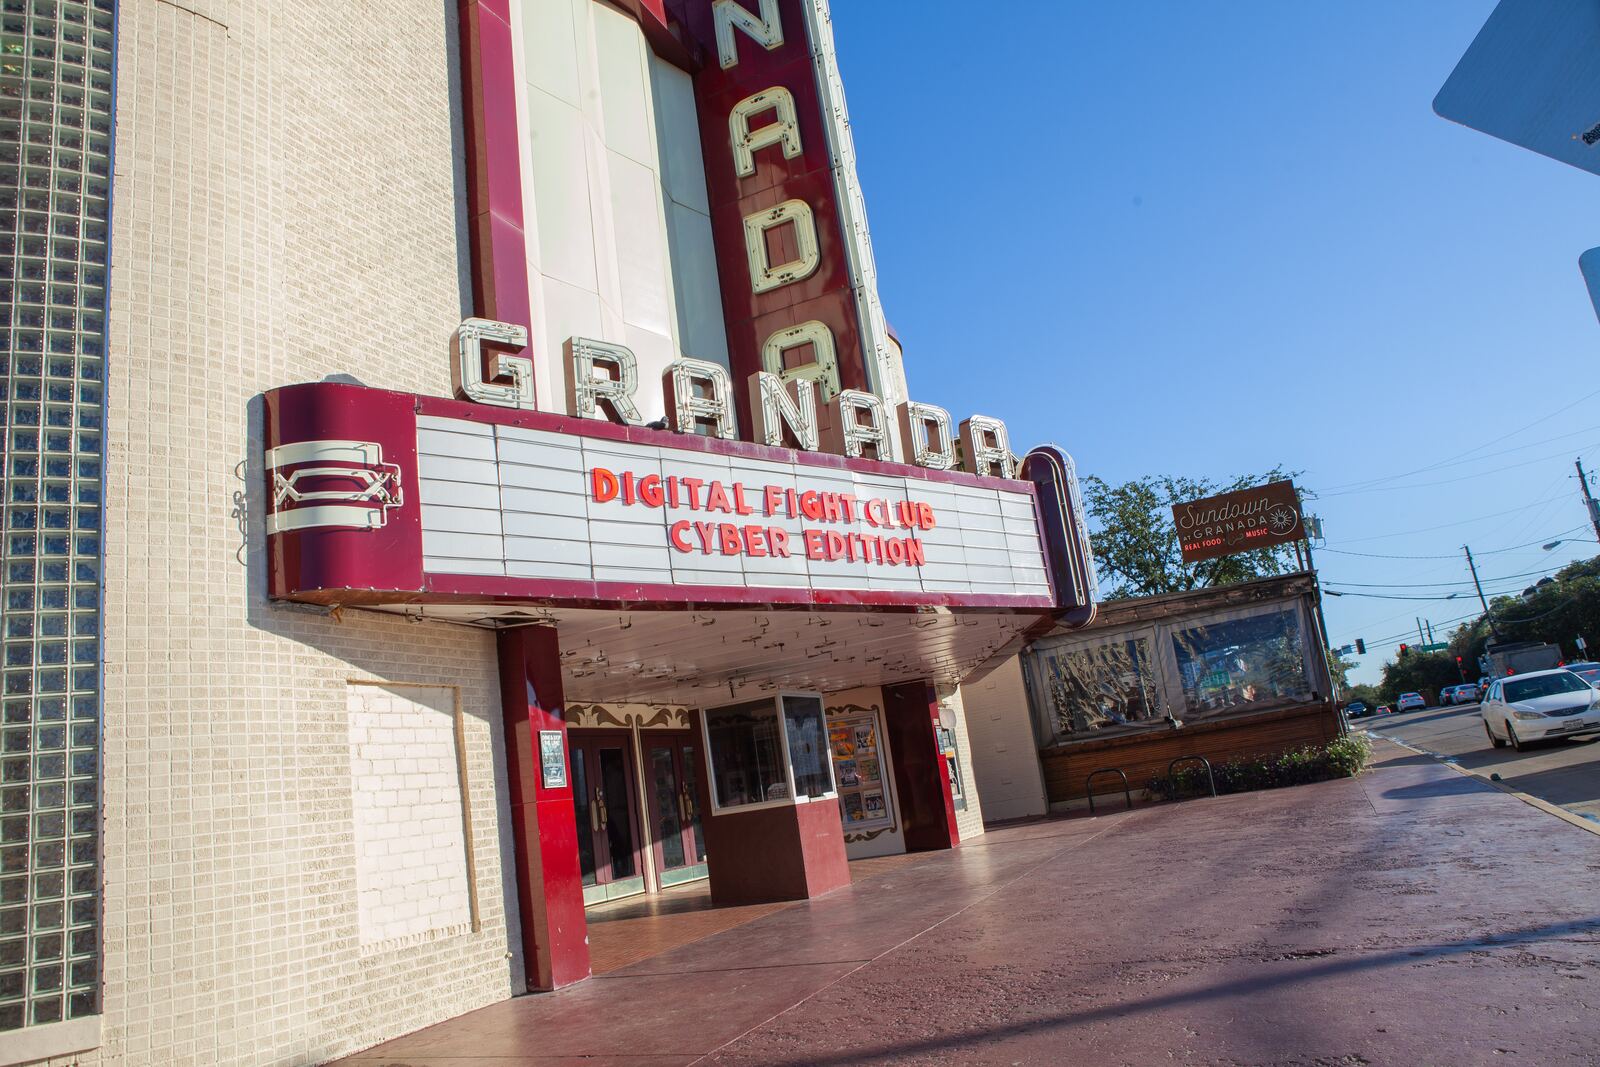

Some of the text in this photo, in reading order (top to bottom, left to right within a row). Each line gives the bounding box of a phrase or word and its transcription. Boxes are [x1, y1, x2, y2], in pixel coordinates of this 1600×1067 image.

[451, 317, 1015, 479] GRANADA
[591, 467, 936, 531] DIGITAL FIGHT CLUB
[1180, 497, 1276, 529] Sundown
[669, 519, 925, 567] CYBER EDITION
[1184, 543, 1201, 552] REAL
[1202, 537, 1222, 548] FOOD
[1245, 527, 1268, 539] MUSIC
[1193, 514, 1268, 540] GRANADA
